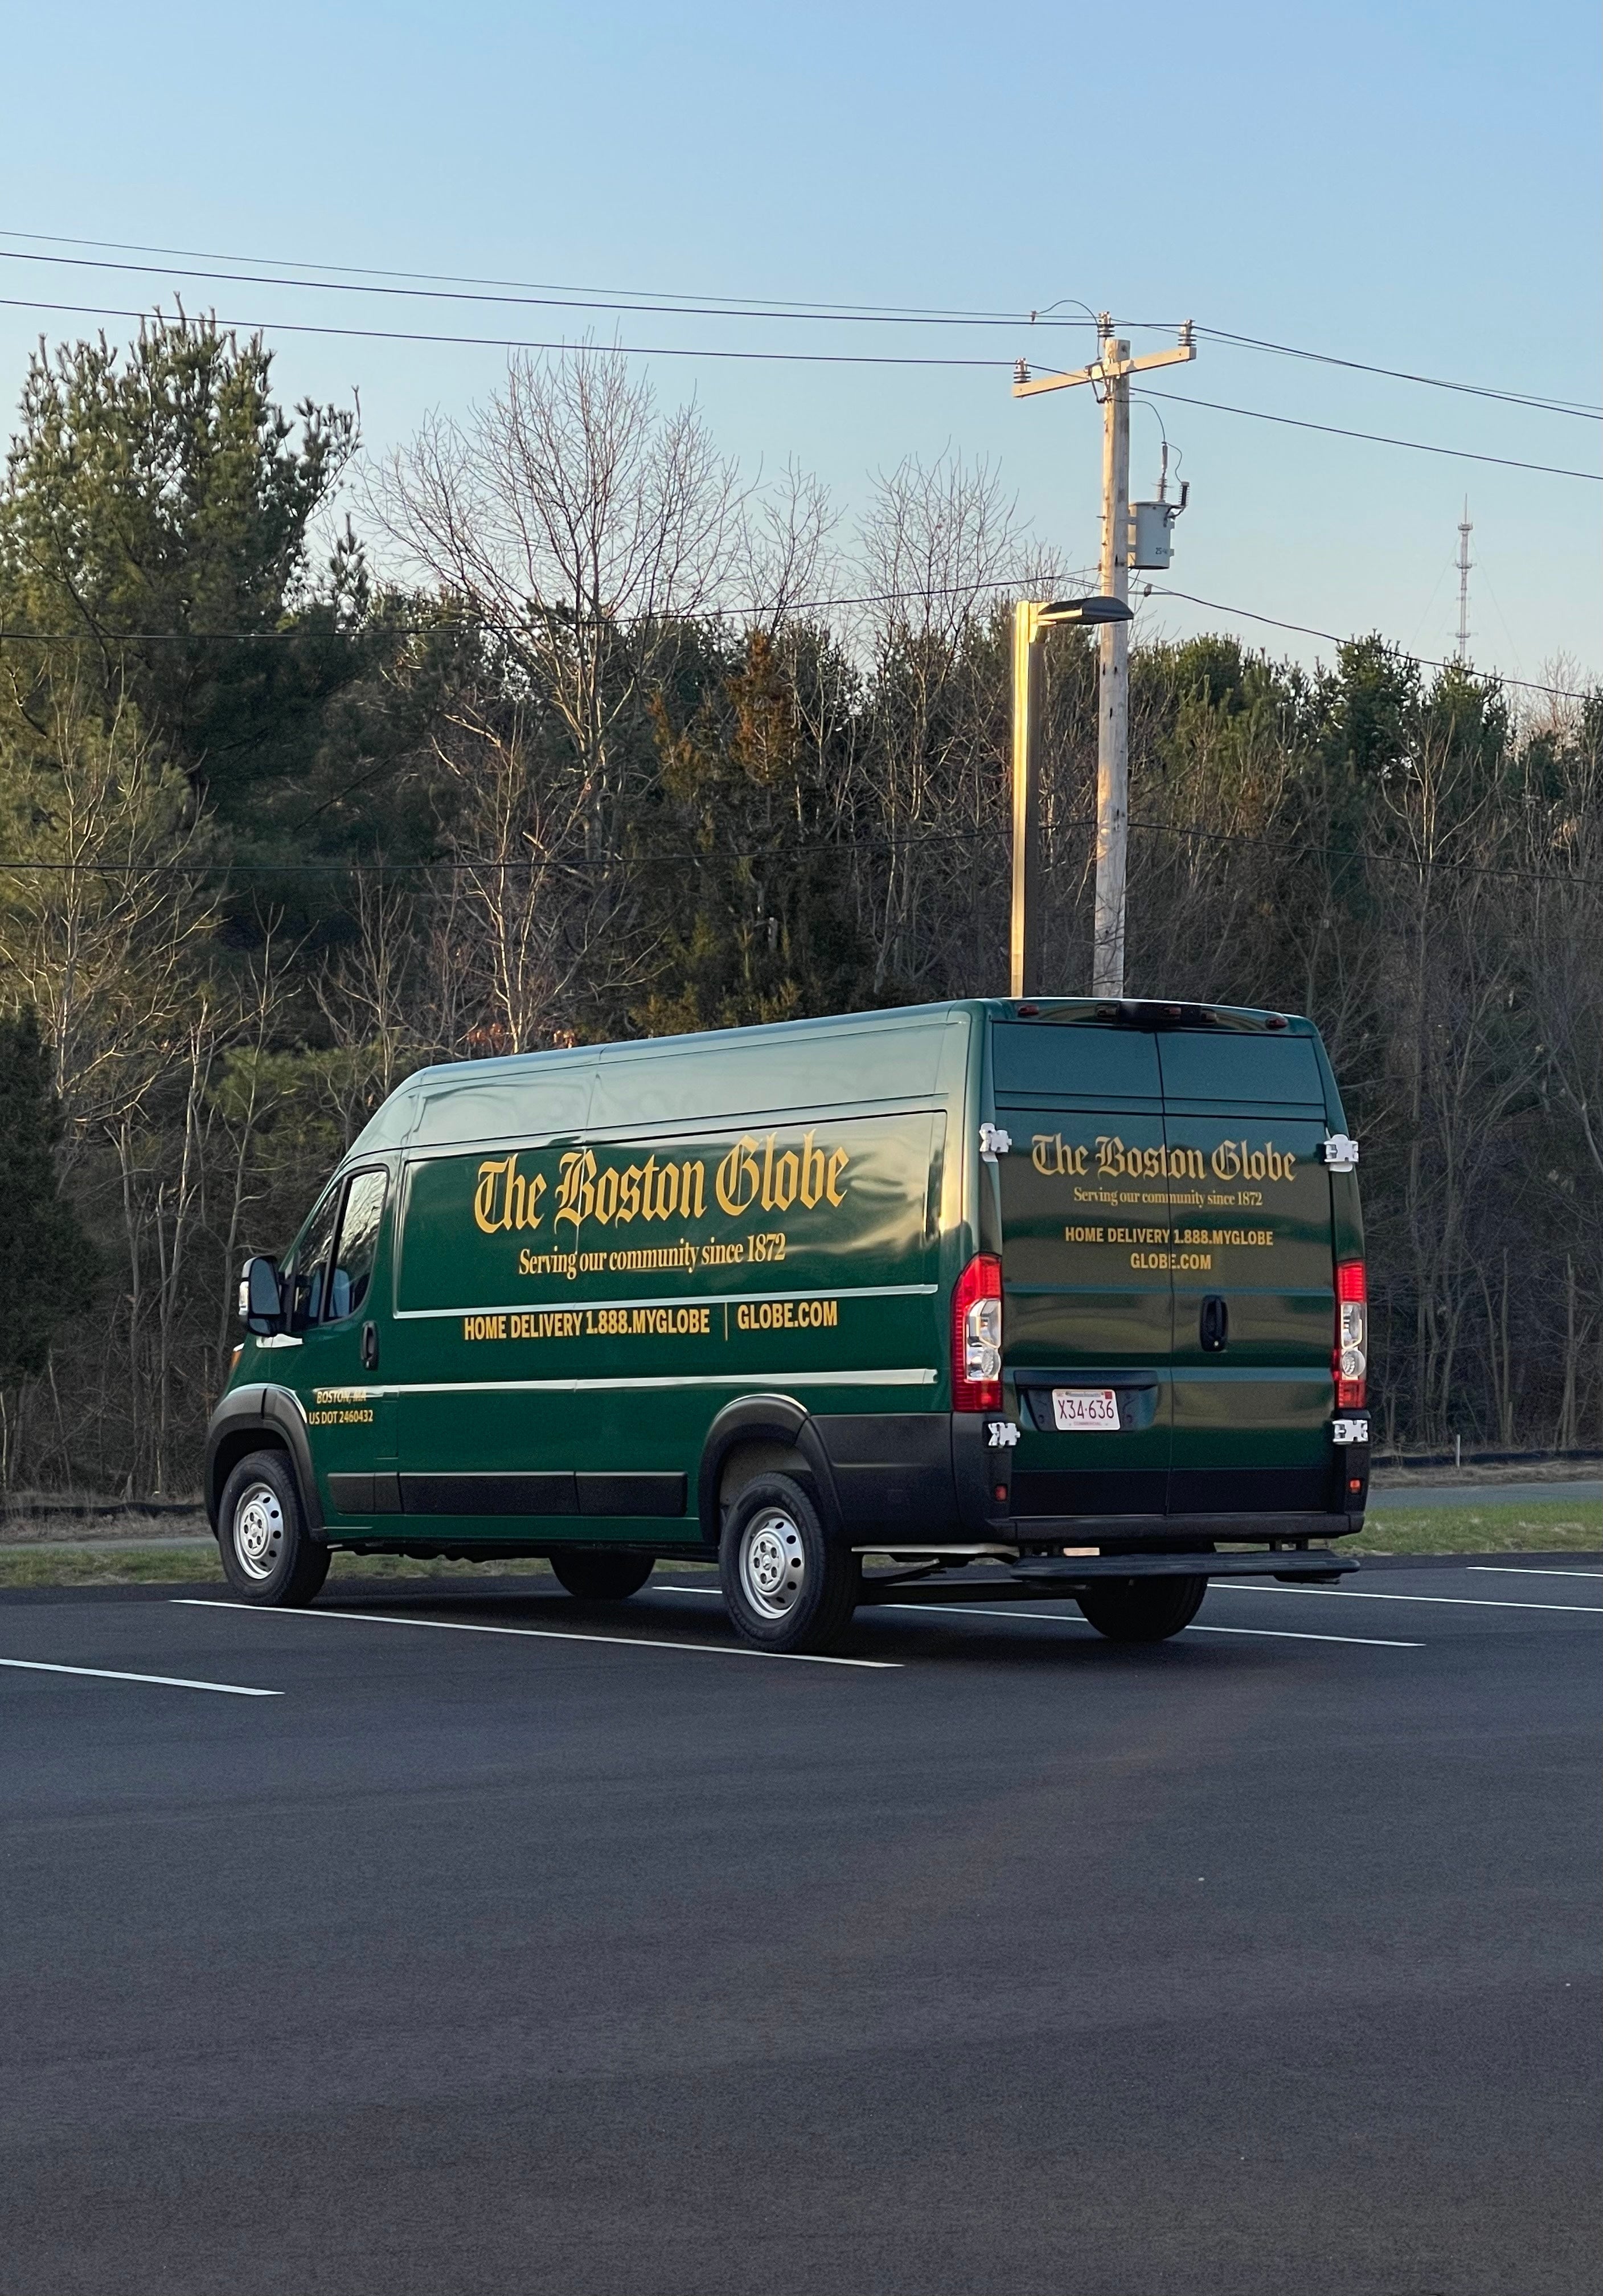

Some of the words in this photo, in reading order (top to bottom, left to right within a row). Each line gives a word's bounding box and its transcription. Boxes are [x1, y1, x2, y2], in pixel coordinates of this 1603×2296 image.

[1032, 1132, 1089, 1176] The
[1095, 1136, 1207, 1181] Boston
[1212, 1140, 1297, 1181] Globe
[474, 1153, 547, 1233] The
[554, 1149, 707, 1235] Boston
[716, 1128, 850, 1216] Globe
[1074, 1186, 1118, 1206] Serving
[1120, 1192, 1140, 1203] our
[1142, 1189, 1204, 1208] community
[1207, 1190, 1235, 1205] since
[1237, 1191, 1263, 1206] 1872
[1065, 1227, 1104, 1242] HOME
[1108, 1228, 1170, 1243] DELIVERY
[1174, 1229, 1273, 1246] 1.888.MYGLOBE
[519, 1245, 577, 1280] Serving
[579, 1253, 607, 1271] our
[609, 1240, 699, 1274] community
[701, 1237, 743, 1265] since
[747, 1233, 786, 1262] 1872
[1130, 1253, 1211, 1270] GLOBE.COM
[464, 1315, 507, 1340] HOME
[511, 1312, 583, 1339] DELIVERY
[586, 1309, 710, 1335] 1.888.MYGLOBE
[737, 1301, 837, 1329] GLOBE.COM
[317, 1390, 351, 1404] BOSTON,
[309, 1412, 319, 1425] US
[321, 1411, 338, 1424] DOT
[339, 1410, 374, 1423] 2460432
